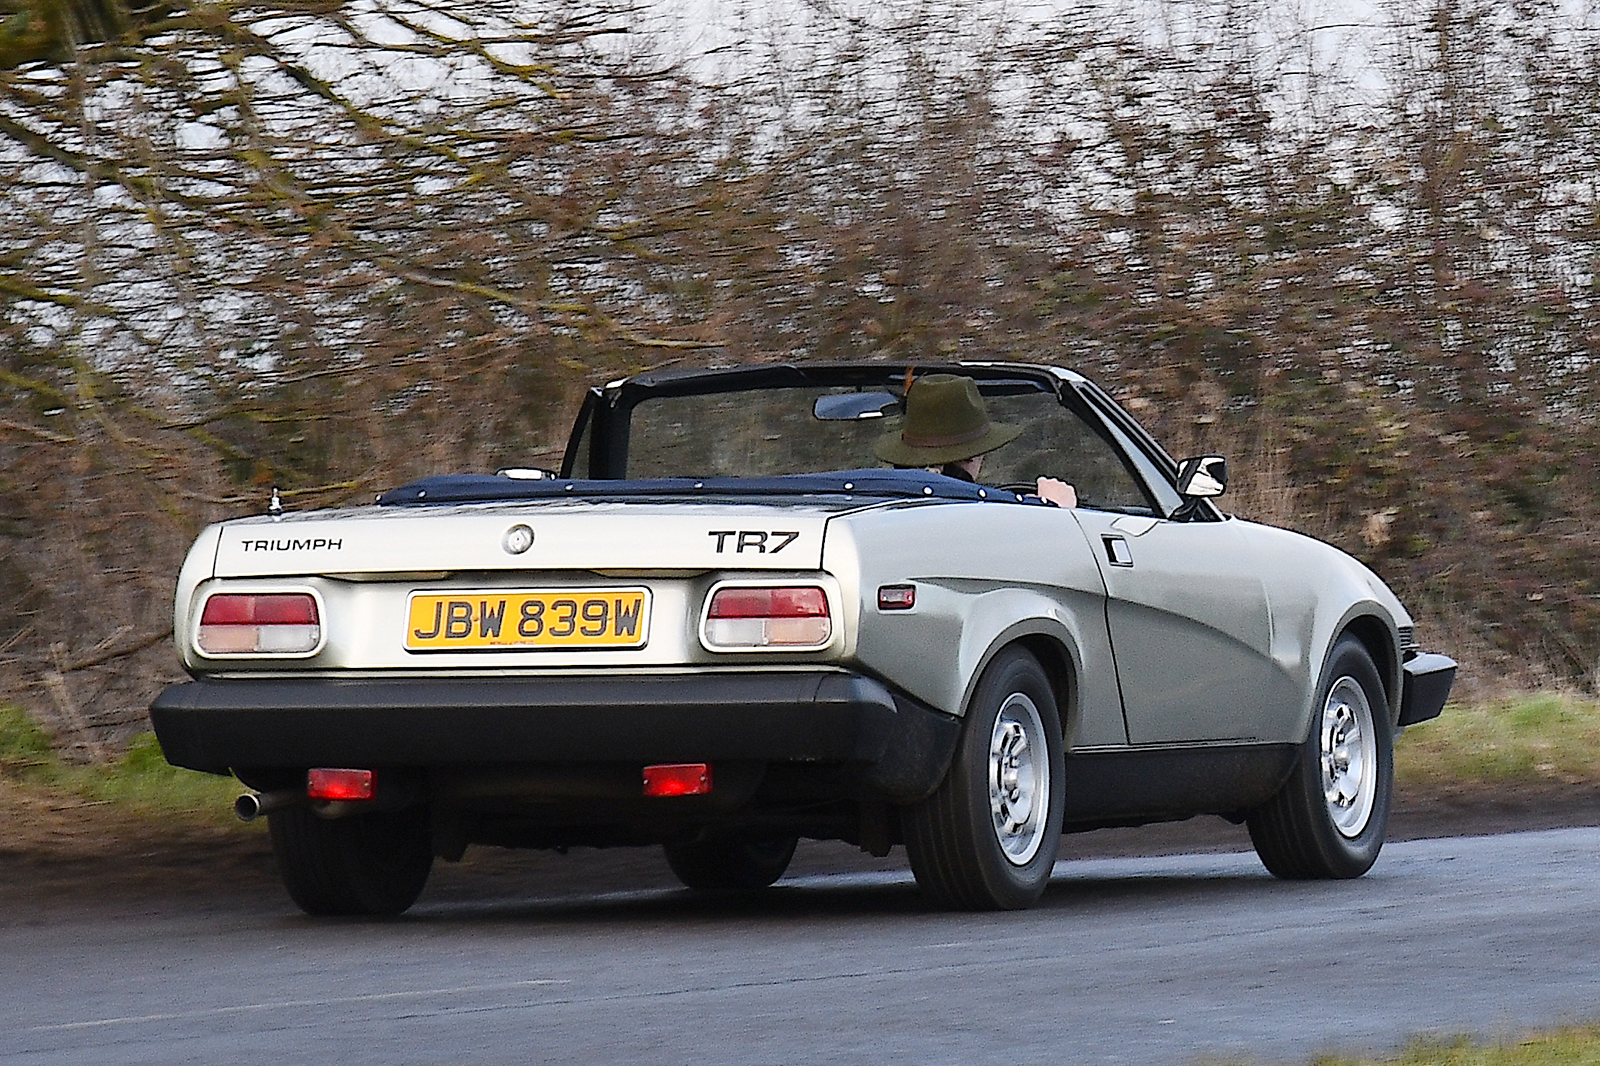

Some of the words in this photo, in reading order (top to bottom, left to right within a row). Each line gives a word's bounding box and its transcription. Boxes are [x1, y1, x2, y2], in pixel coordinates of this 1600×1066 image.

[241, 538, 343, 552] TRIUMPH
[708, 530, 800, 554] TR7
[413, 600, 506, 640] JBW
[517, 598, 642, 638] 839W
